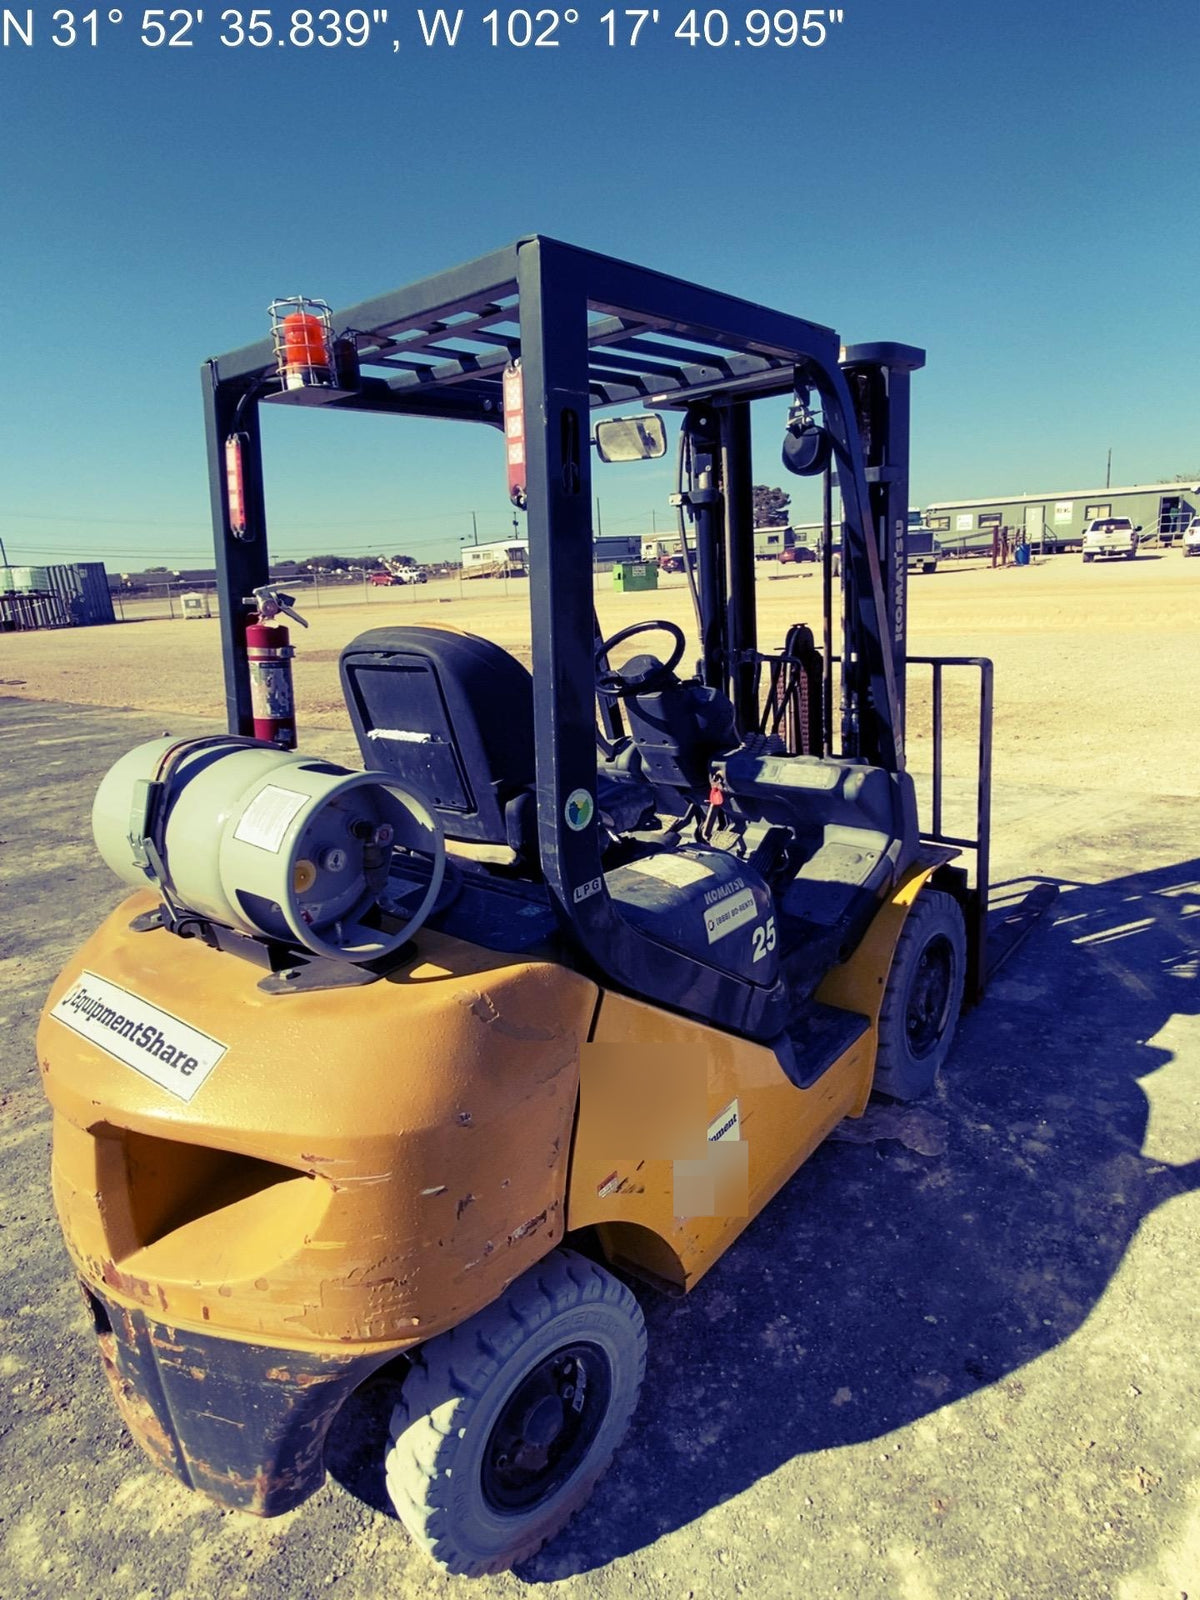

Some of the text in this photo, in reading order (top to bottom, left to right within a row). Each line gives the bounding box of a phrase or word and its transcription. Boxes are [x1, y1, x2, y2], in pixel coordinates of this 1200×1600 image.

[894, 519, 904, 642] KOMATSU
[703, 877, 745, 905] KOMATSU
[752, 916, 777, 963] 25
[70, 988, 199, 1077] EquipmentShare
